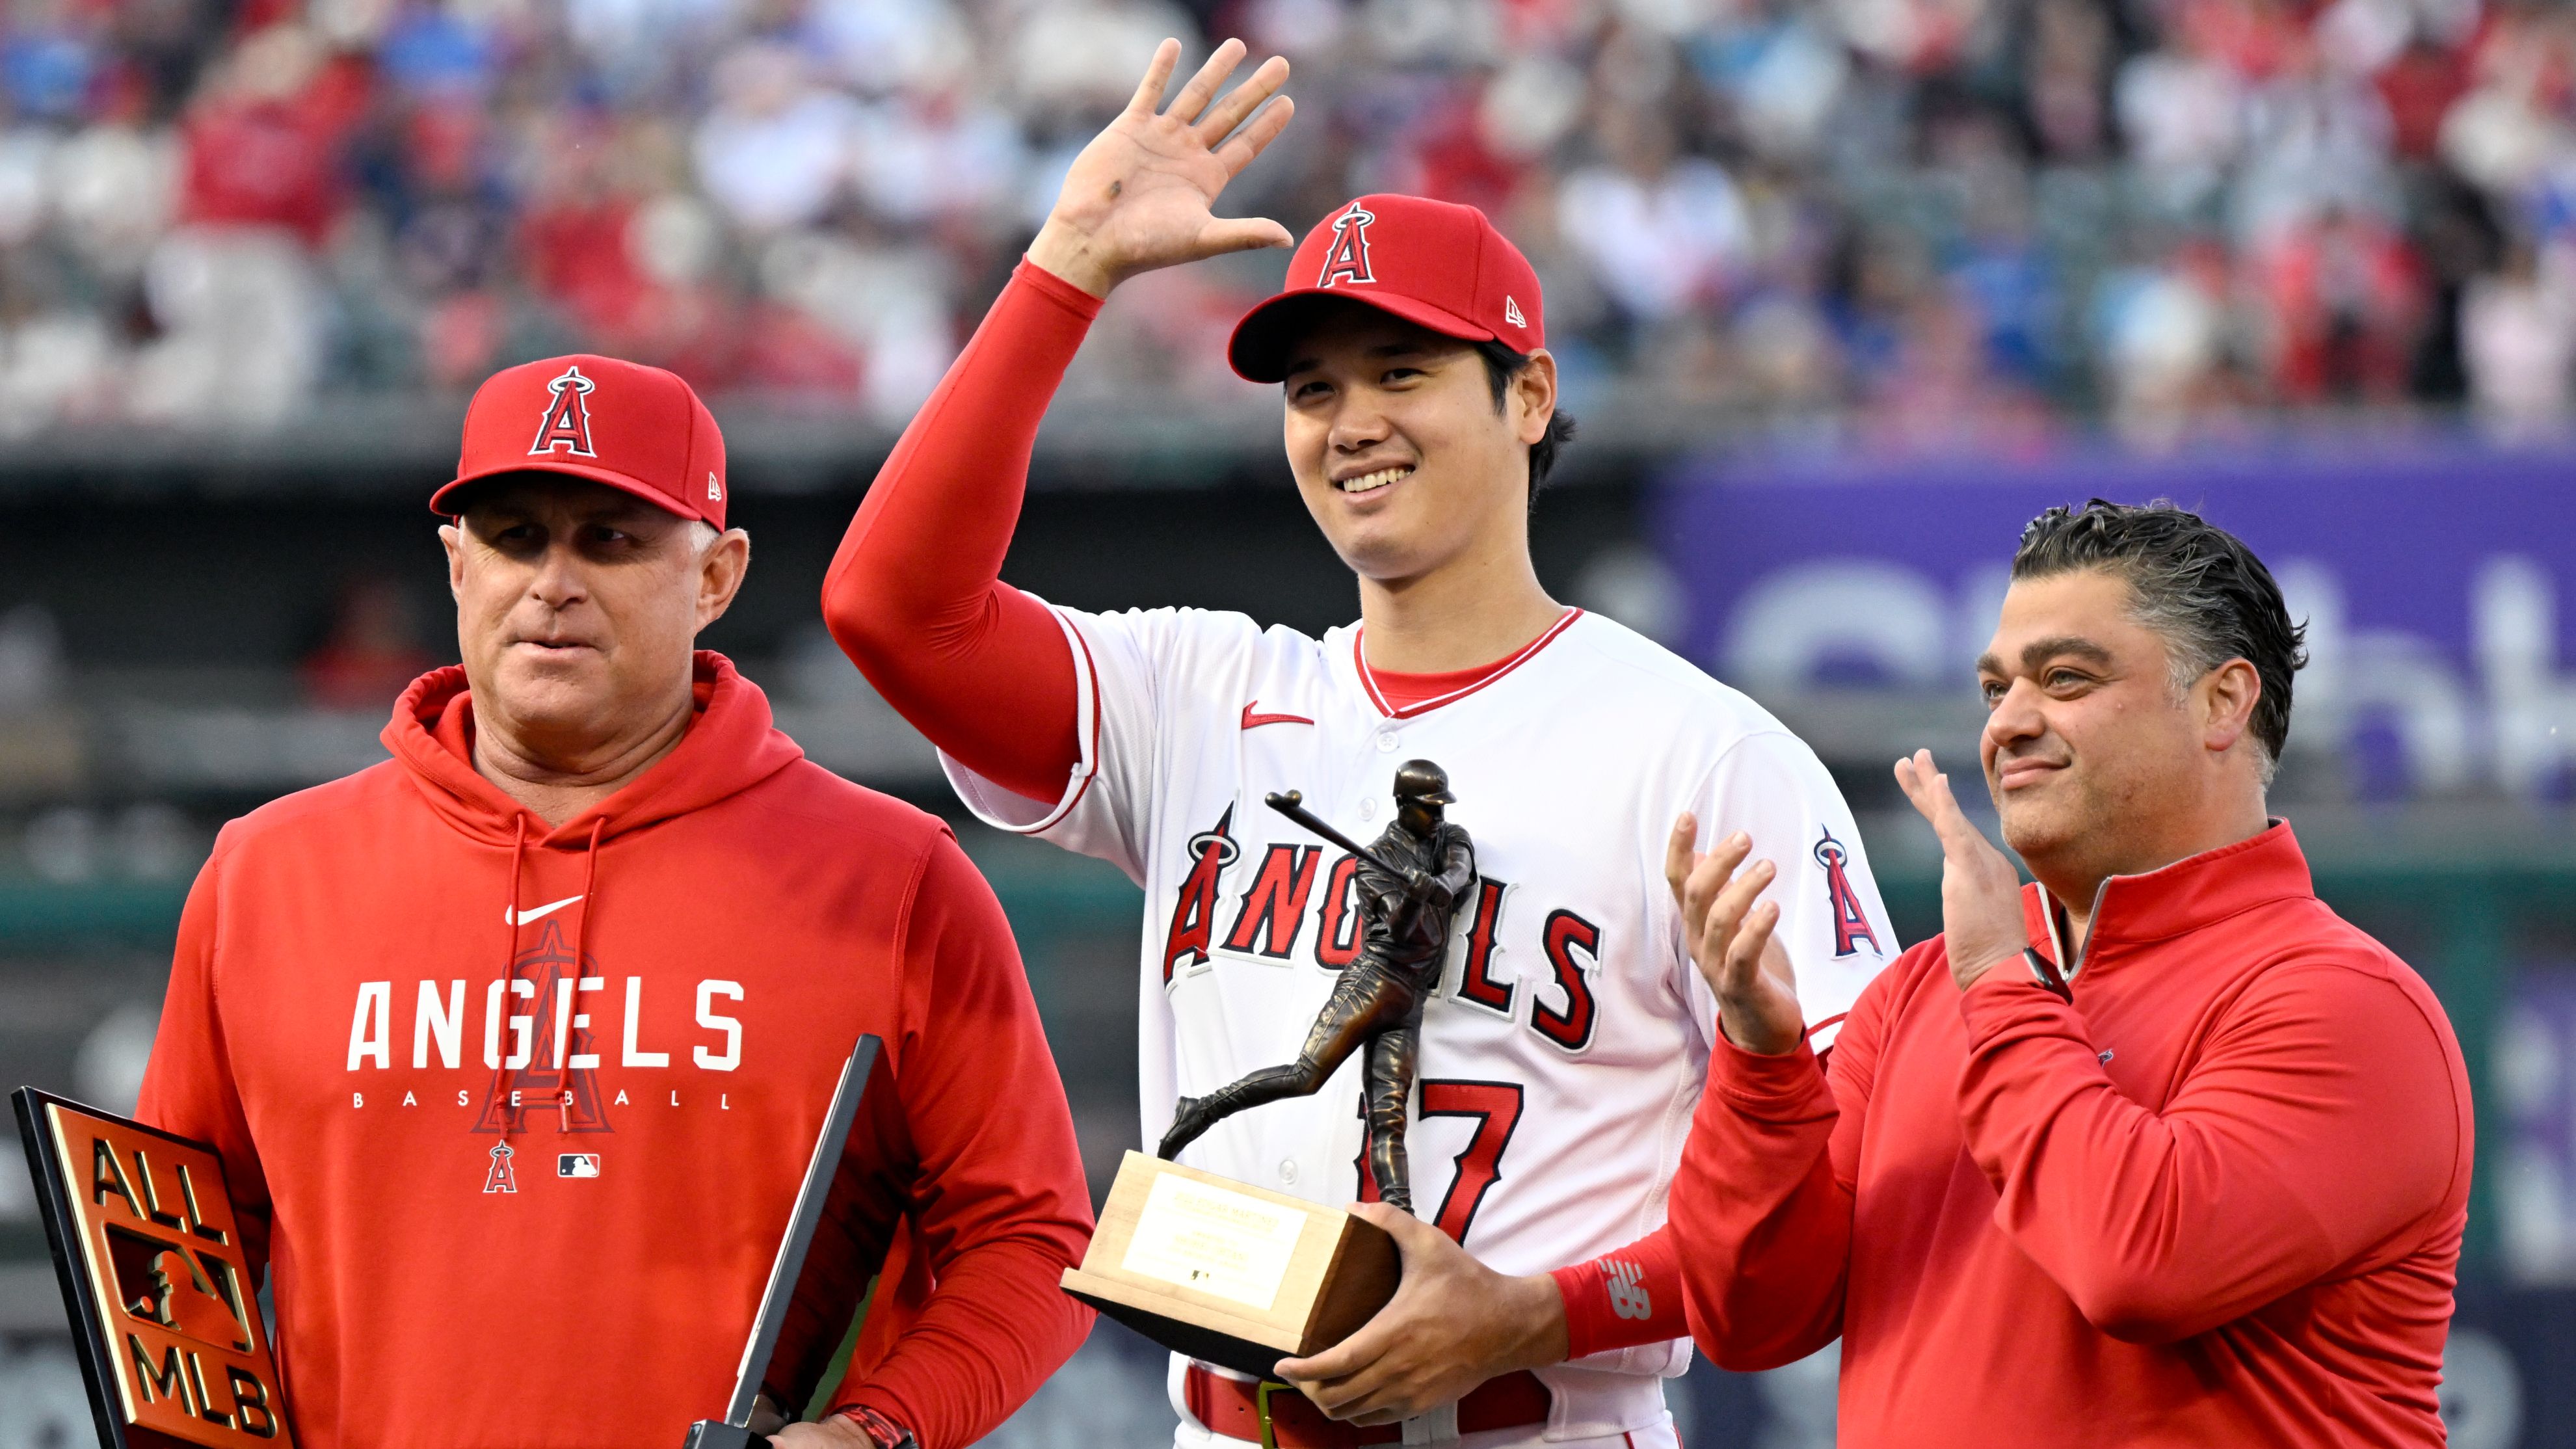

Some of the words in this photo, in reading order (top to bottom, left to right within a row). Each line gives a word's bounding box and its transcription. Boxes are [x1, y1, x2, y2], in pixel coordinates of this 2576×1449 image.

[1317, 202, 1377, 288] A
[527, 366, 598, 457] A
[1163, 788, 1605, 1055] ANLS
[347, 976, 744, 1070] ANGELS
[354, 1089, 729, 1110] BASEBALL
[93, 1138, 228, 1246] ALL
[128, 1332, 277, 1438] MLB
